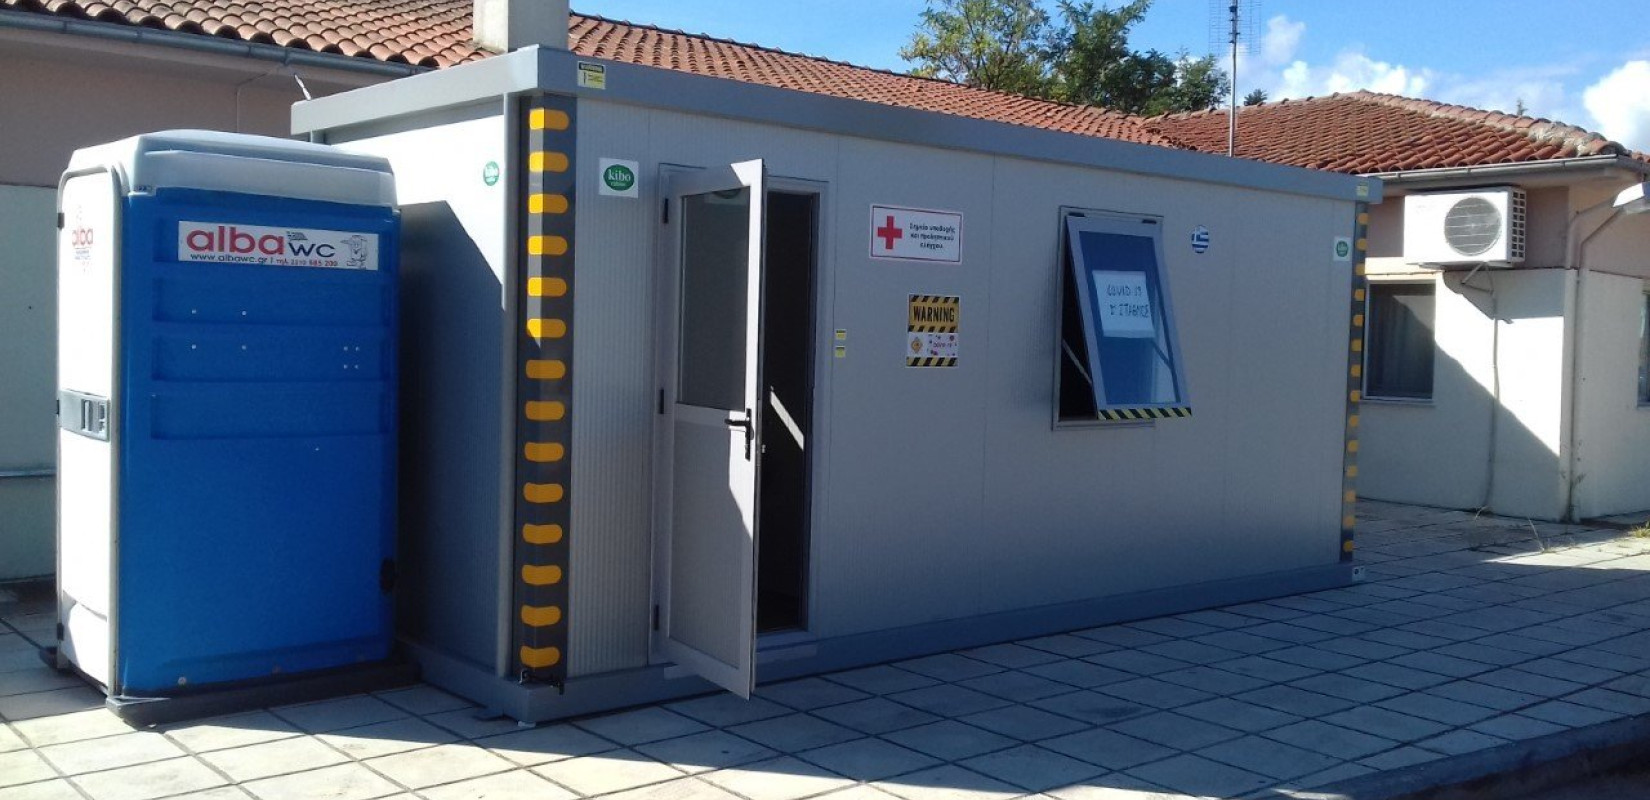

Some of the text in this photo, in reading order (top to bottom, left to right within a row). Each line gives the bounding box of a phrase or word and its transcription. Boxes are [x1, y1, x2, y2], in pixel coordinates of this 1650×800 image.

[608, 169, 631, 182] kibo
[186, 226, 285, 255] alba
[190, 253, 268, 265] www.albawc.gr
[913, 306, 955, 322] WARNING
